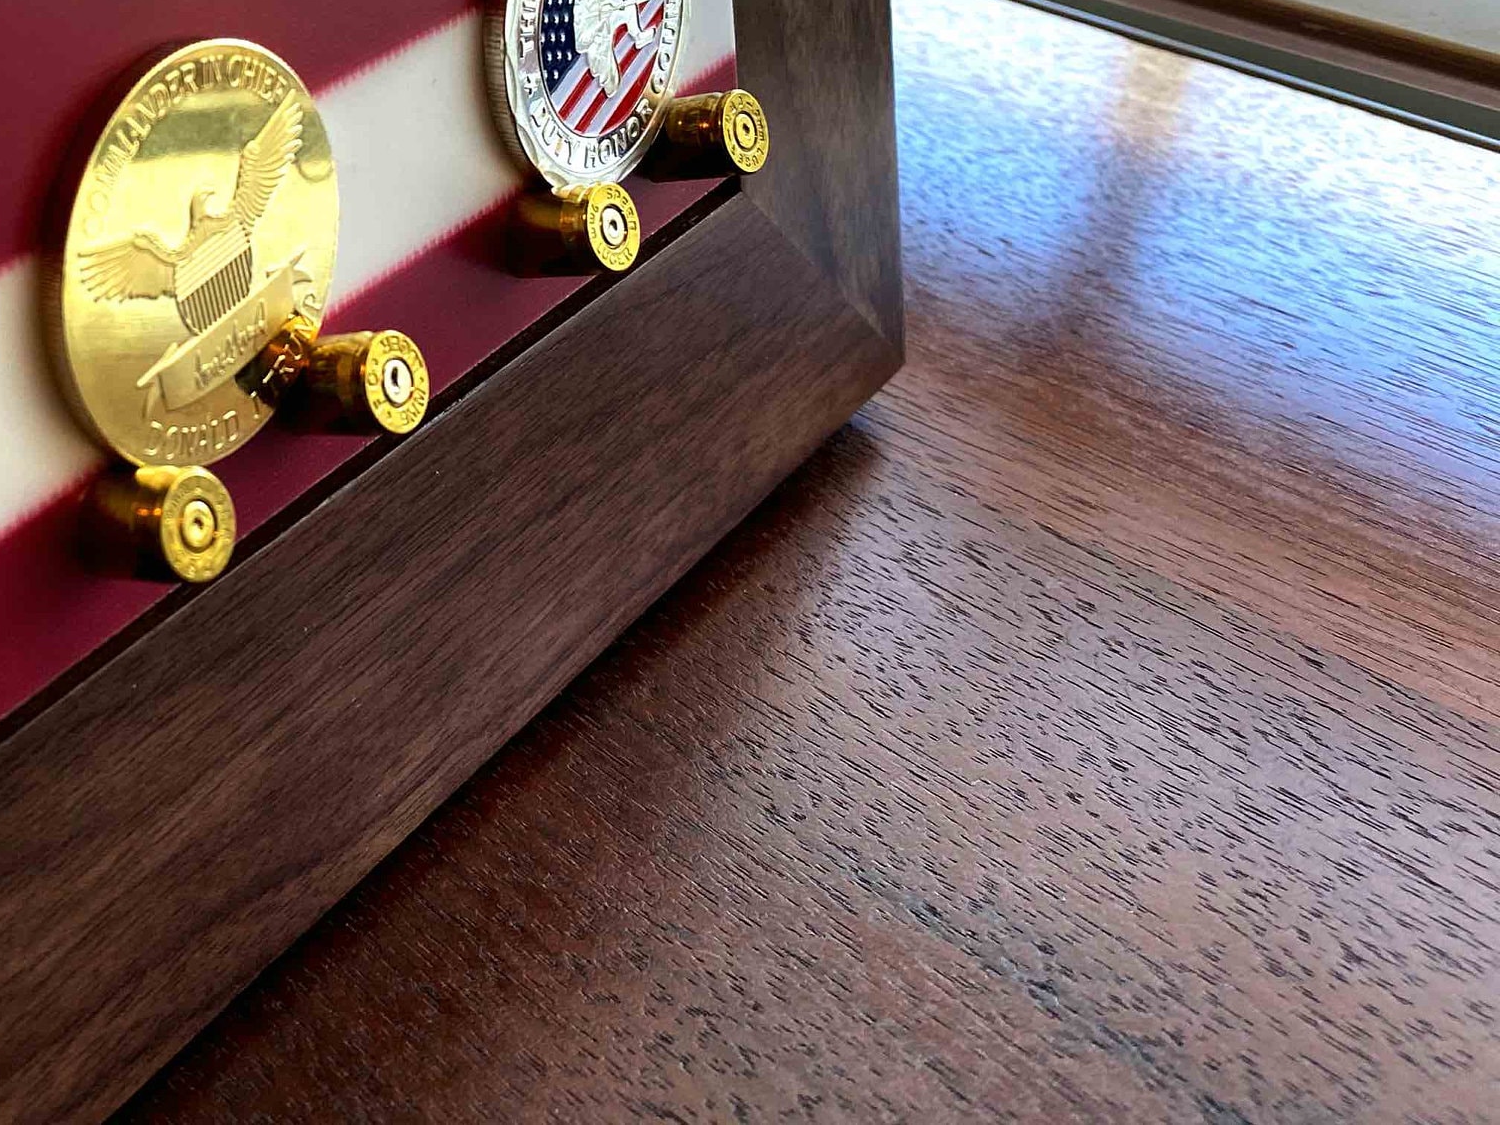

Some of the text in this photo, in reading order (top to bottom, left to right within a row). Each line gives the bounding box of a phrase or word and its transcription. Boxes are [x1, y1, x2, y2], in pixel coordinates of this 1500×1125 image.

[200, 54, 226, 91] IN
[226, 54, 289, 105] CHIEF
[583, 98, 654, 169] HONOR
[589, 203, 633, 266] 9mm LUGER
[606, 187, 638, 232] SPEER
[143, 410, 240, 461] DONALD
